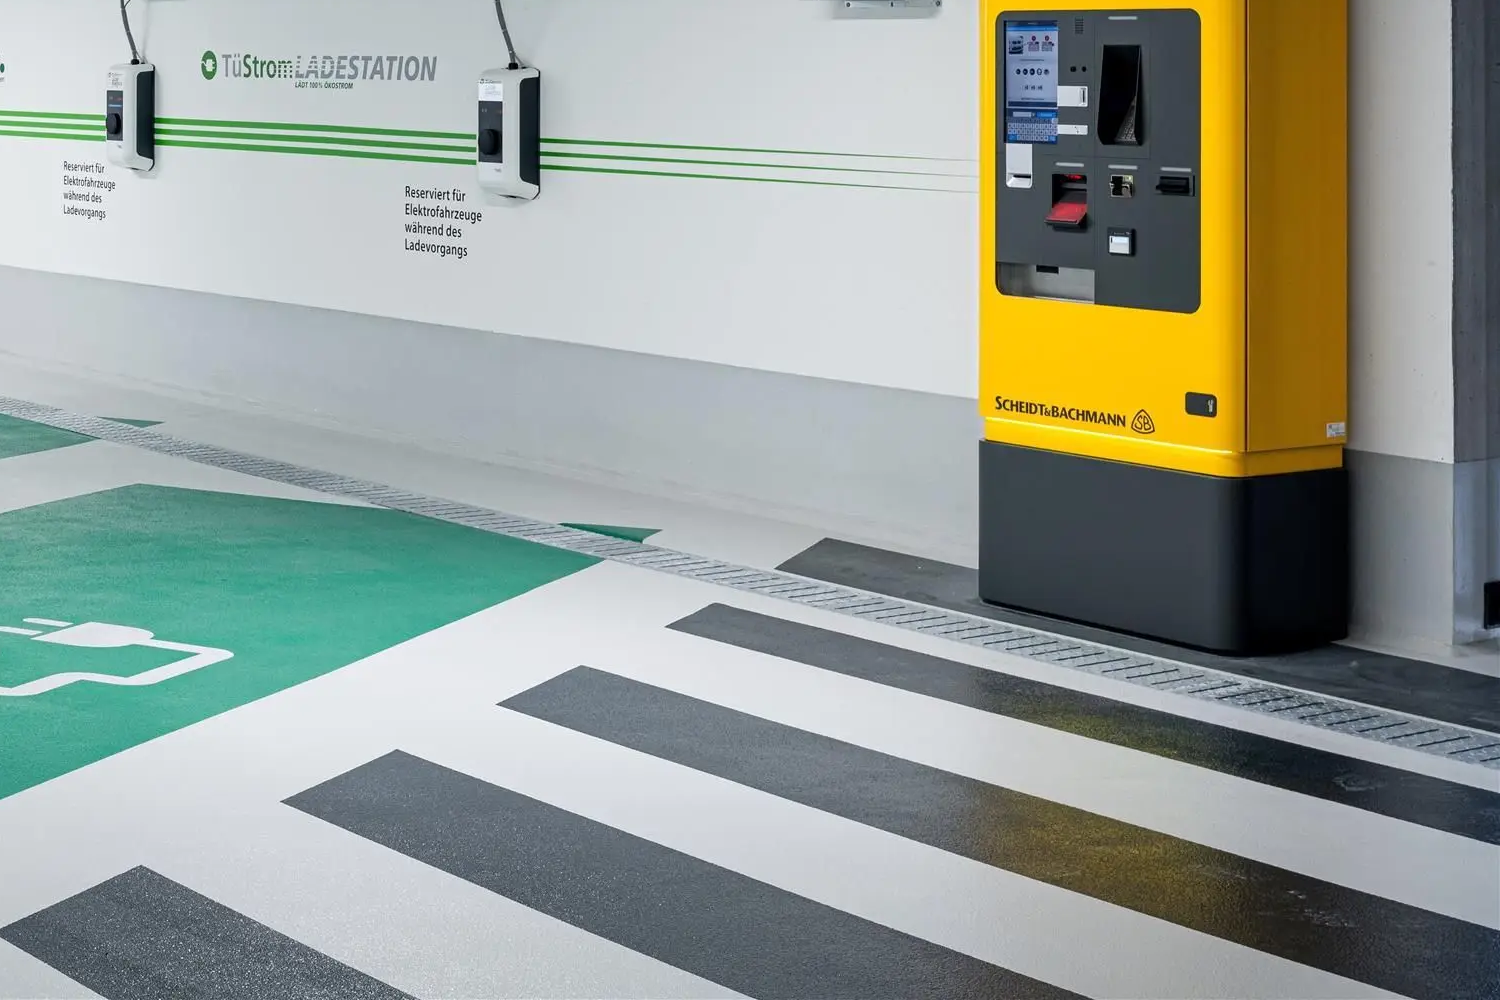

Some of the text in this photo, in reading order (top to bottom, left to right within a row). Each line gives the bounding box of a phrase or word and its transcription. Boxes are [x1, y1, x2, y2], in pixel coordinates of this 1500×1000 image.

[63, 160, 105, 173] Reserviert für
[63, 175, 116, 192] Elektrofahrzeuge
[63, 190, 102, 203] während des
[405, 185, 466, 202] Reserviert für
[63, 204, 106, 221] Ladevorgangs
[405, 203, 482, 224] Elektrofahrzeuge
[404, 221, 462, 238] während des
[404, 238, 468, 259] Ladevorgangs
